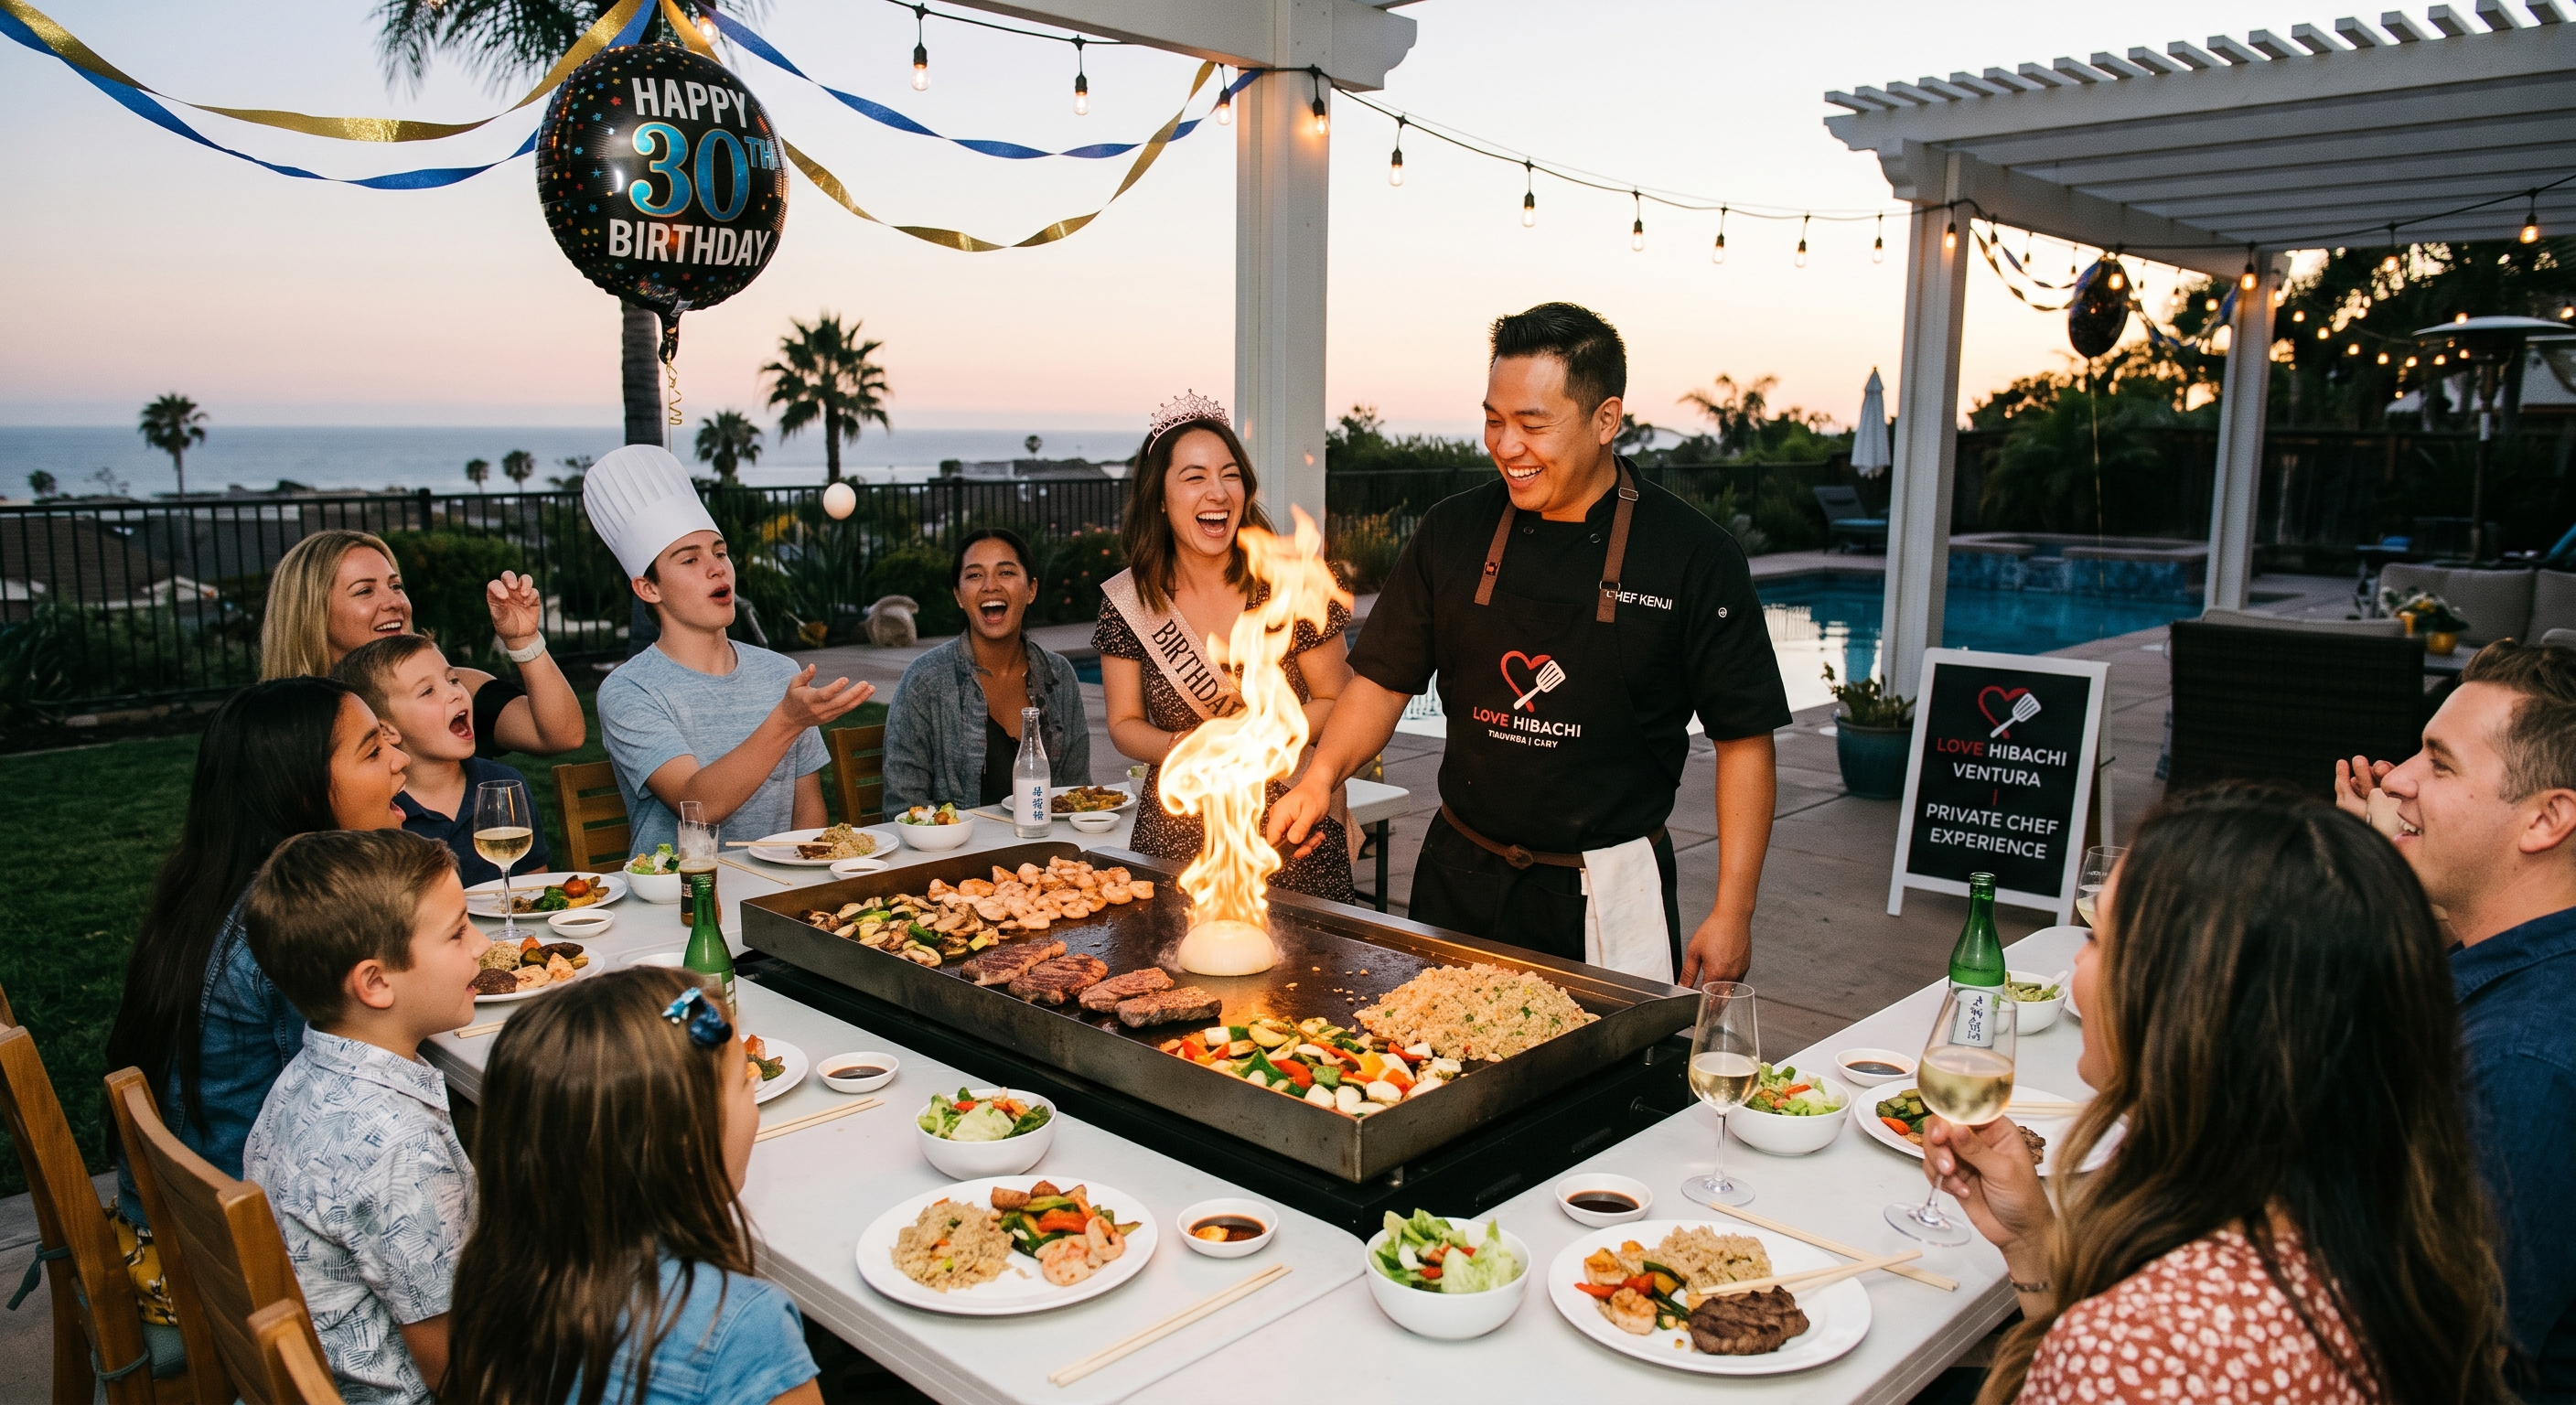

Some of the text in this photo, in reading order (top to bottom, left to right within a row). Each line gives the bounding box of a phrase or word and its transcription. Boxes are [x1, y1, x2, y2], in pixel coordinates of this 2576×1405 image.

[631, 77, 747, 129] HAPPY
[628, 121, 776, 222] 30TH
[608, 218, 771, 267] BIRTHDAY
[1638, 594, 1673, 610] KENJI
[1473, 706, 1582, 737] LOVE HIBACHI
[1937, 737, 2067, 767] LOVE HIBACHI
[1953, 762, 2041, 788] VENTURA
[1926, 802, 2059, 835] PRIVATE CHEF
[1929, 827, 2047, 860] EXPERIENCE
